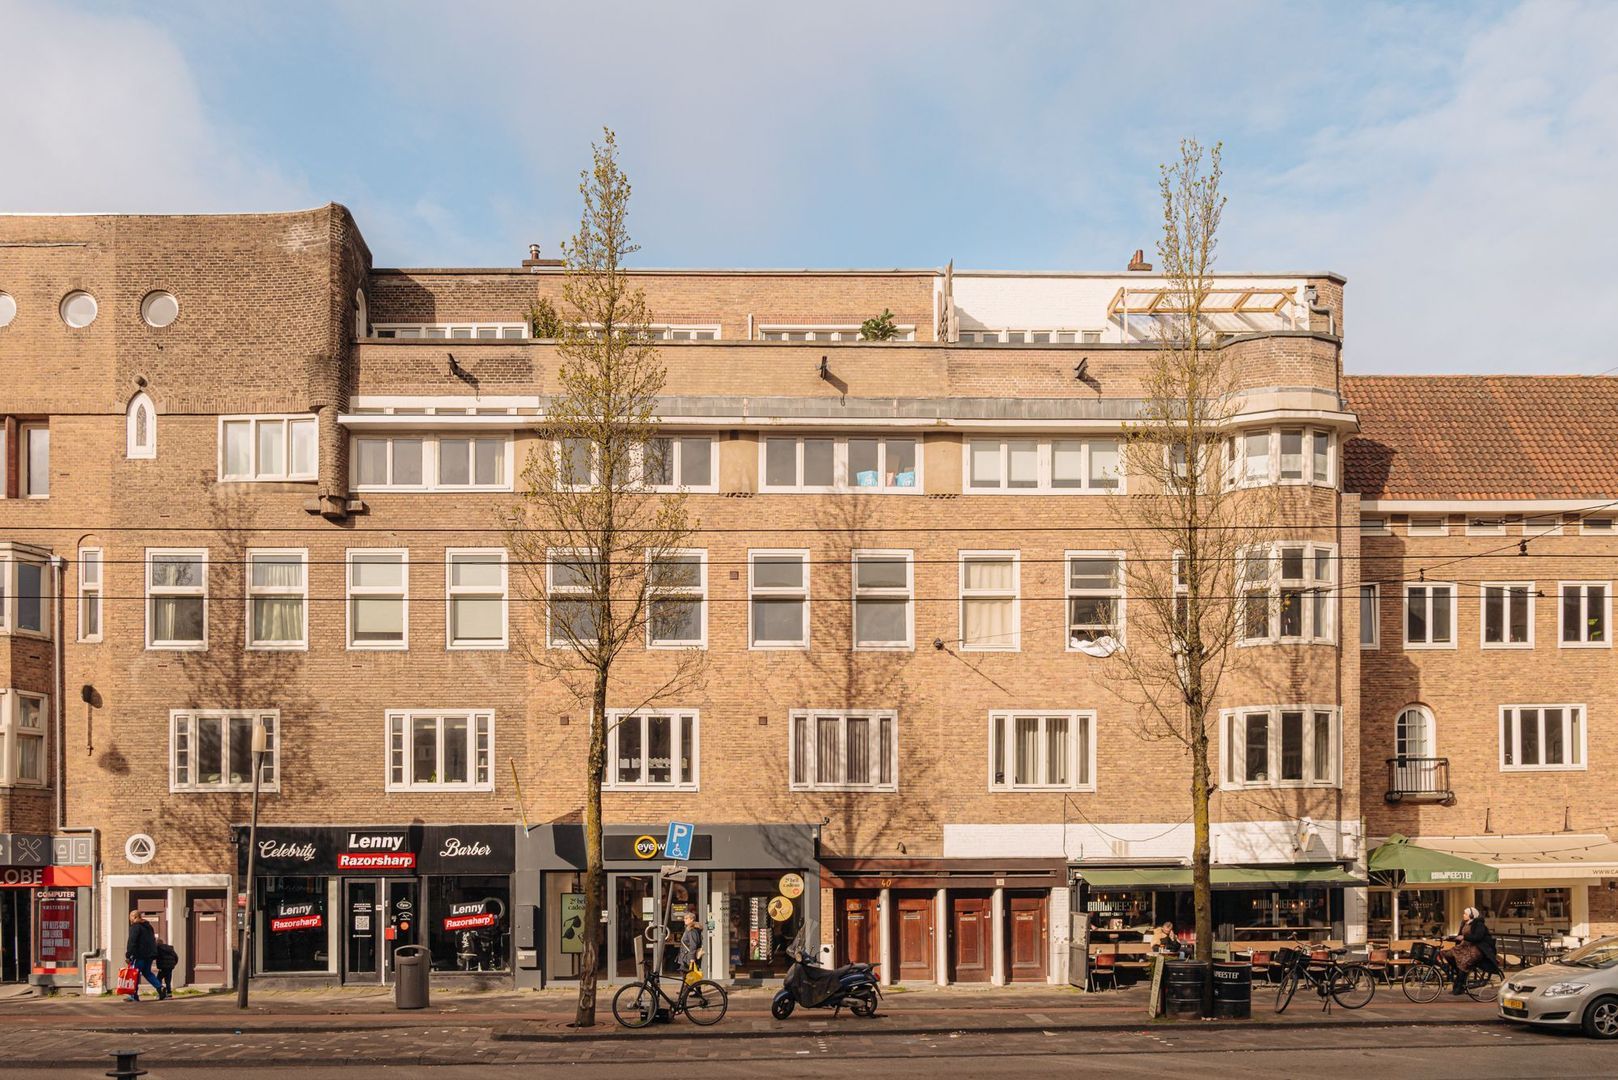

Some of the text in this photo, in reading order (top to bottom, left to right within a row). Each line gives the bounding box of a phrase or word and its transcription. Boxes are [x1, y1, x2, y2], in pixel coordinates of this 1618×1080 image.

[673, 825, 687, 842] P
[349, 834, 403, 851] Lenny
[440, 838, 491, 857] Barber
[258, 839, 317, 862] Celebrity
[340, 855, 412, 867] Razorsharp
[881, 880, 892, 888] 40
[280, 905, 312, 915] Lenny
[452, 904, 484, 915] Lenny
[273, 919, 318, 928] Razorsharp
[446, 917, 490, 928] Razorsharp
